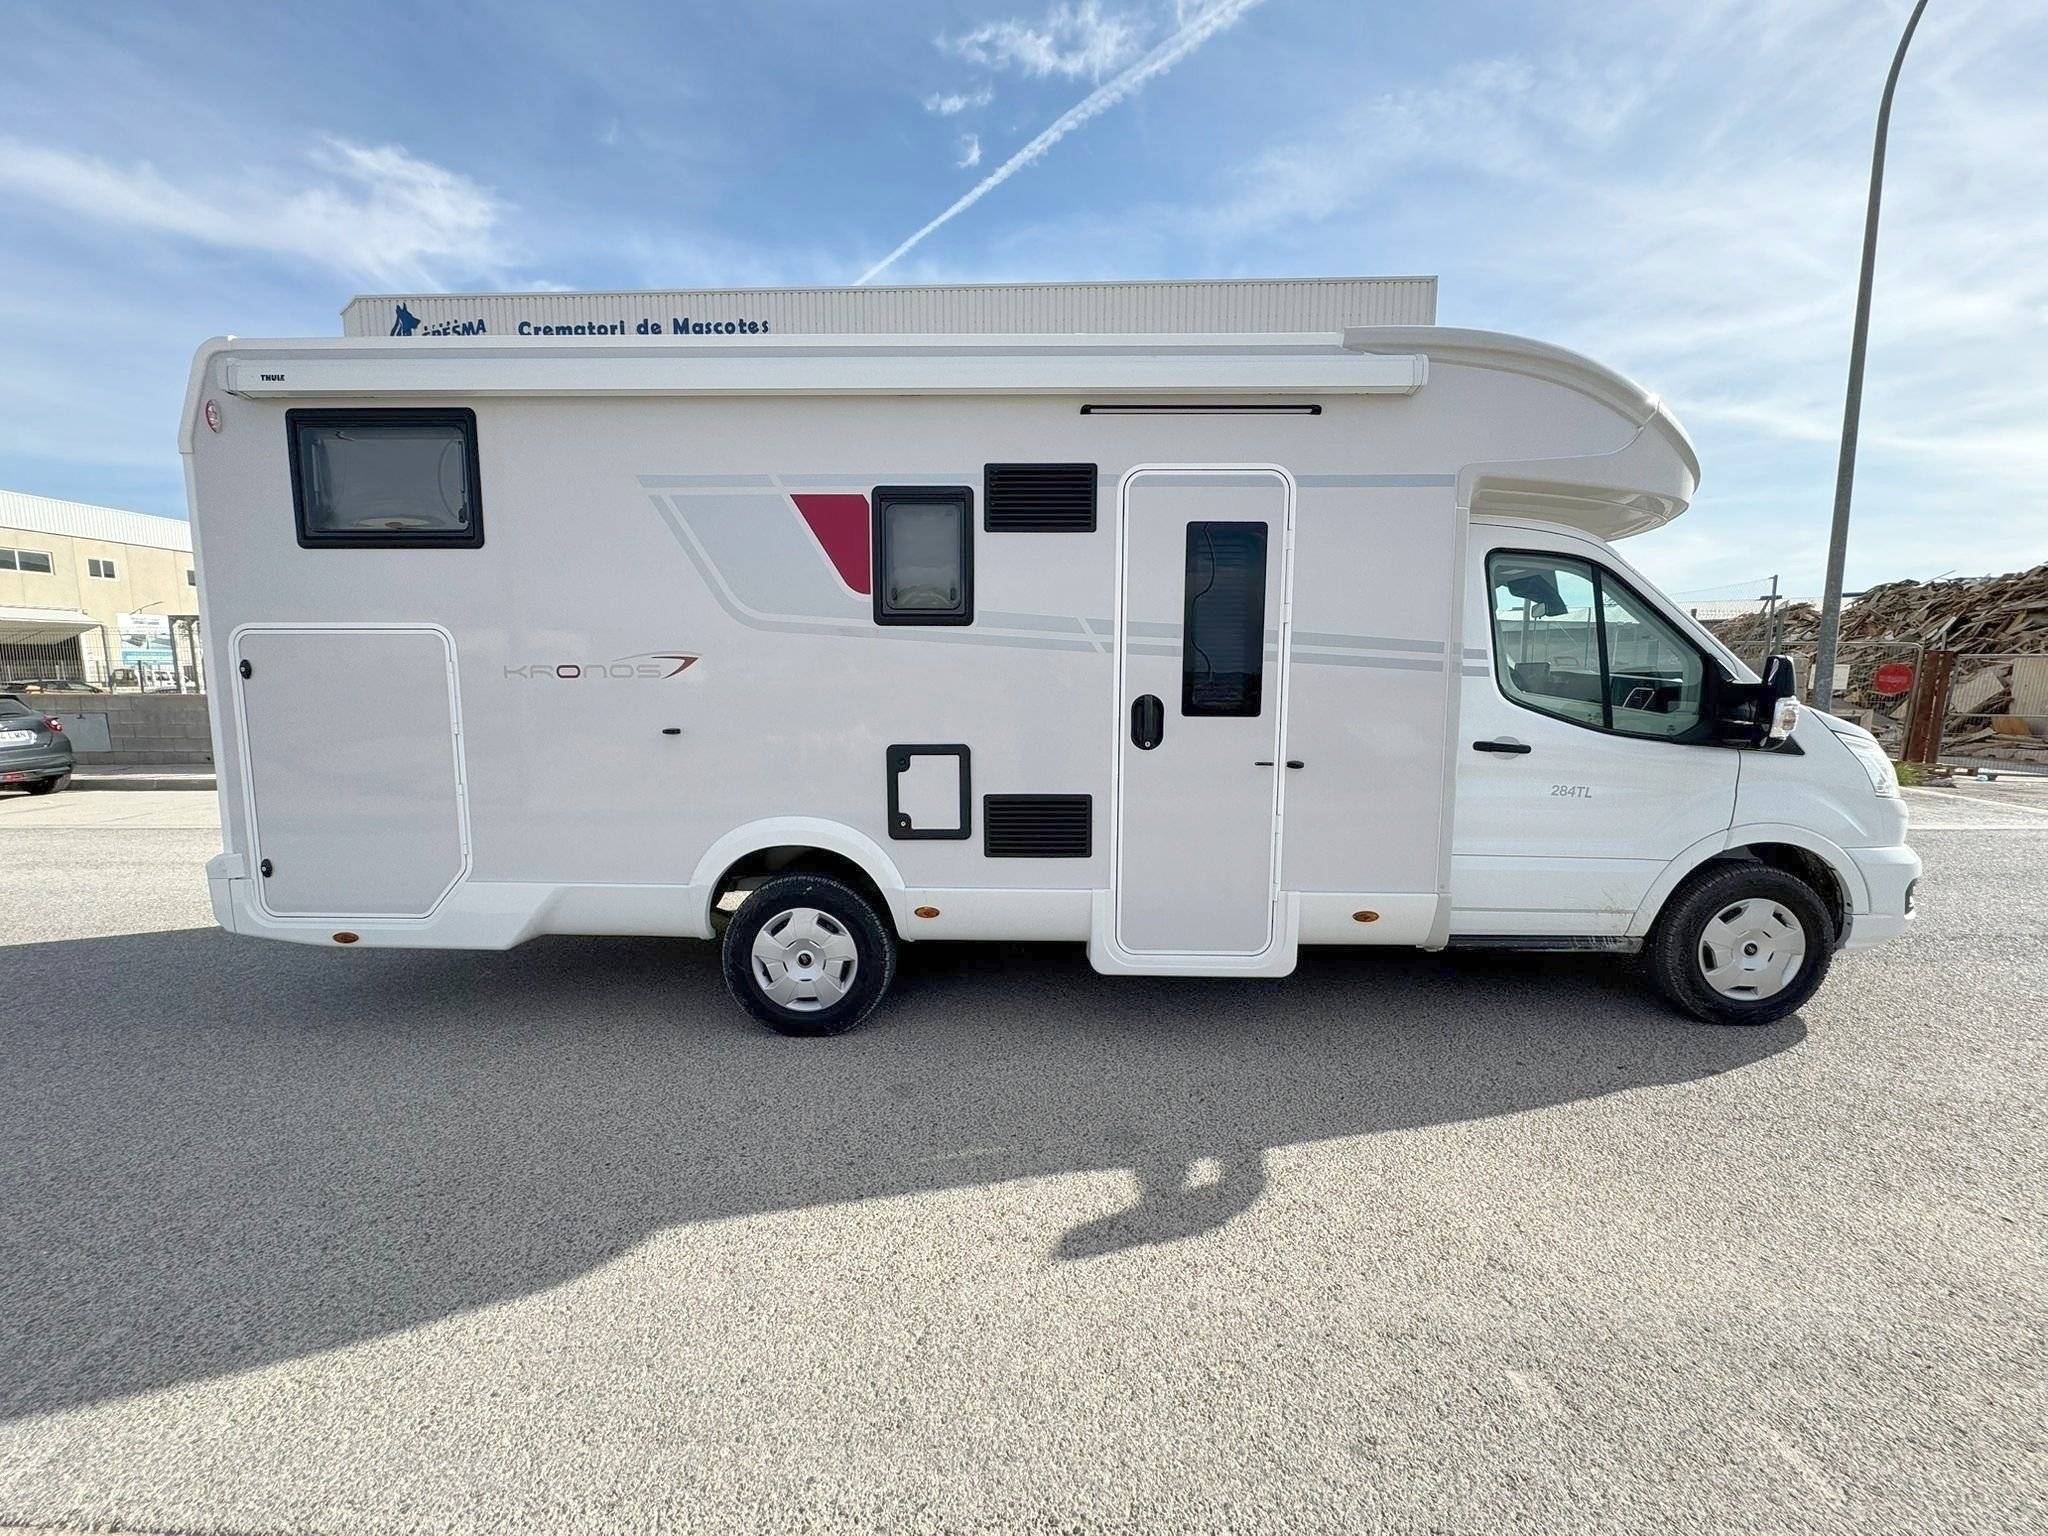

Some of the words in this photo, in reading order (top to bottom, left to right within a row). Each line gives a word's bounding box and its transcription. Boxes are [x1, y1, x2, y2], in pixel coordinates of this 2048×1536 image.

[518, 319, 625, 336] Crematori
[636, 318, 662, 335] de
[672, 317, 769, 335] Mascotes
[260, 374, 286, 382] THULE
[1551, 784, 1593, 799] 284TL
